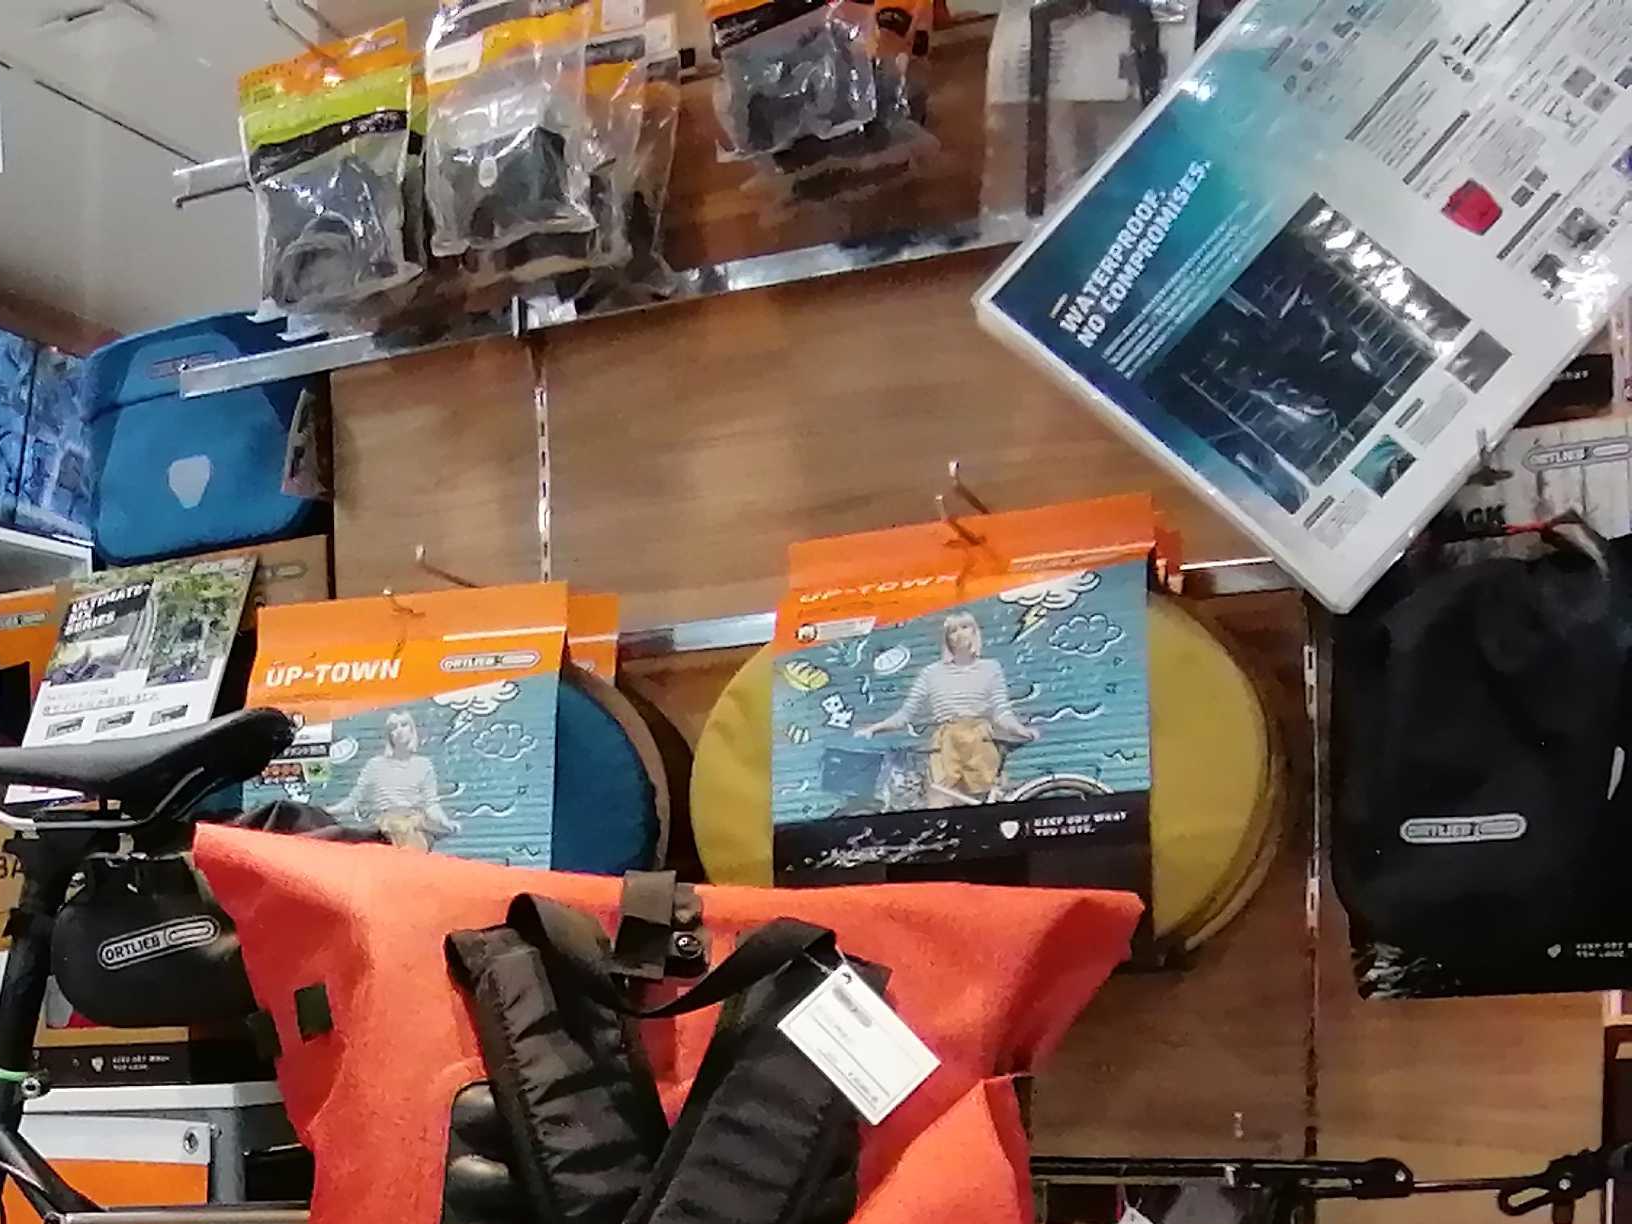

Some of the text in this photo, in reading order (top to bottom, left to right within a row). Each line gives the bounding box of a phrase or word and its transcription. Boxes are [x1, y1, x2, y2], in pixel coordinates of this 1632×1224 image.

[1076, 316, 1106, 349] NO
[800, 574, 958, 604] UP-TOWN
[266, 658, 402, 688] UP-TOWN
[105, 935, 161, 961] ORTLIEB
